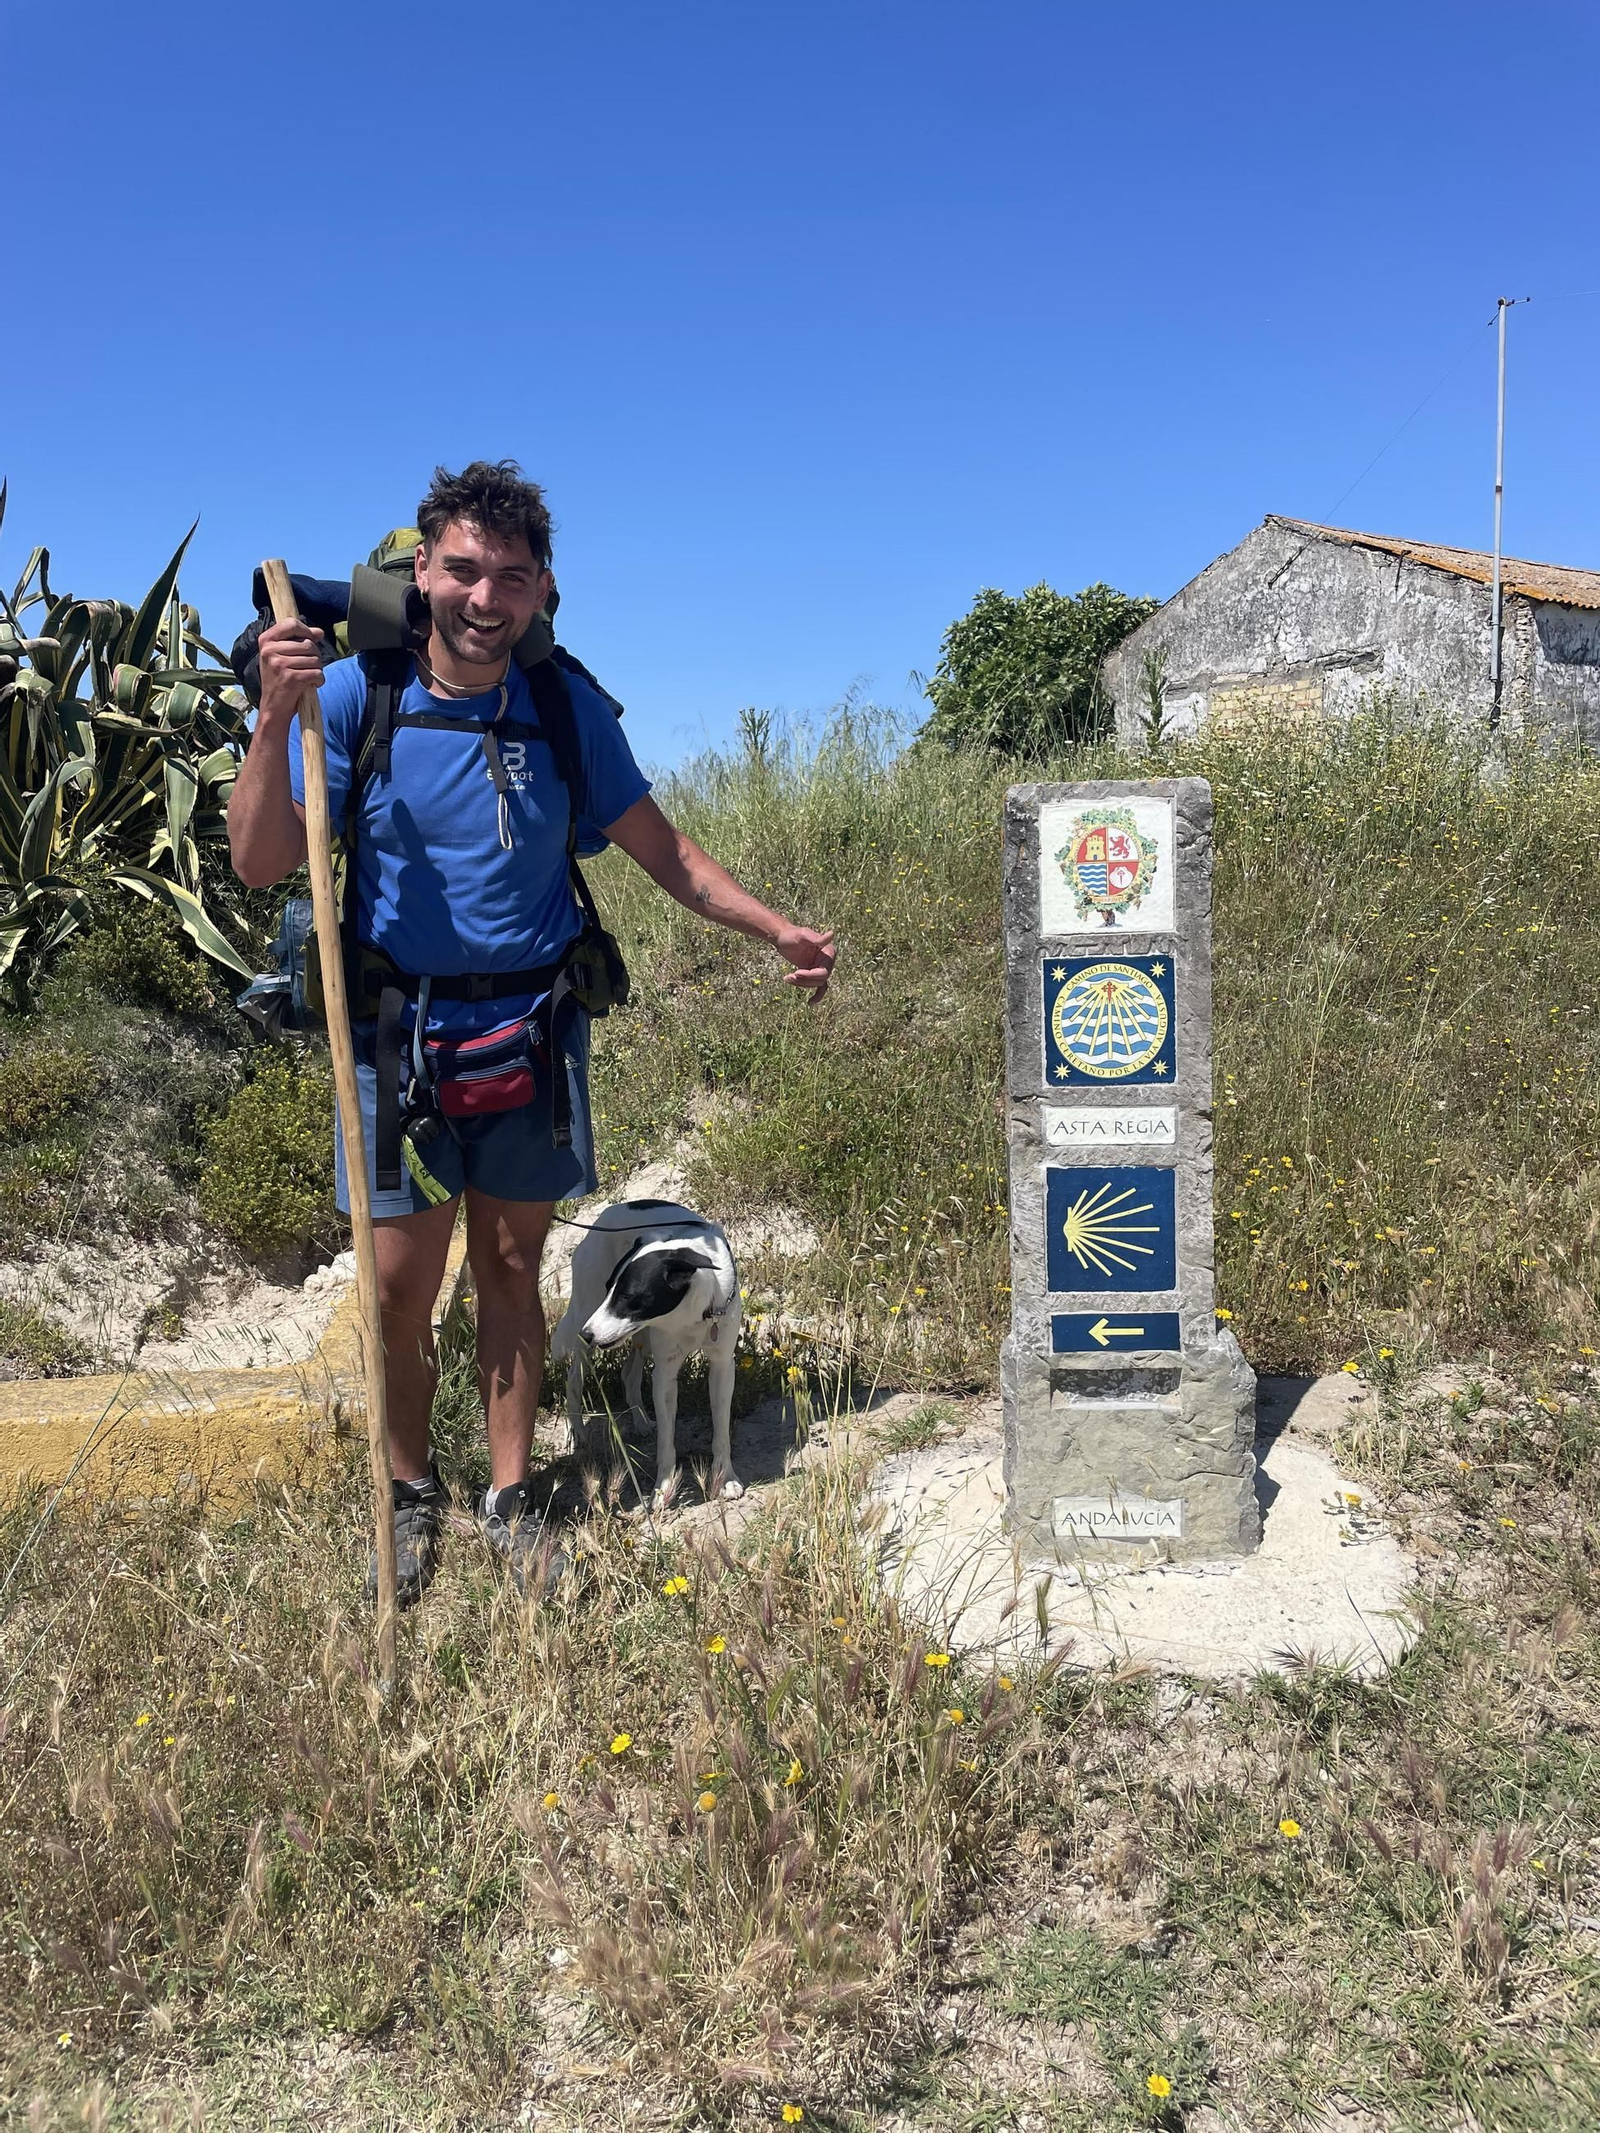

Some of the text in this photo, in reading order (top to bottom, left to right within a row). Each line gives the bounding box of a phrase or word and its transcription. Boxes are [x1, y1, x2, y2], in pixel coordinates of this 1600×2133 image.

[1066, 967, 1098, 991] CAMINO
[1113, 965, 1153, 989] SANTIAGO
[1053, 996, 1066, 1039] CAMINO
[1156, 994, 1167, 1042] AUGUSTA
[1059, 1042, 1105, 1076] CERETANO
[1109, 1067, 1131, 1077] POR
[1133, 1060, 1144, 1070] LA
[1053, 1120, 1169, 1135] ASTA REGIA
